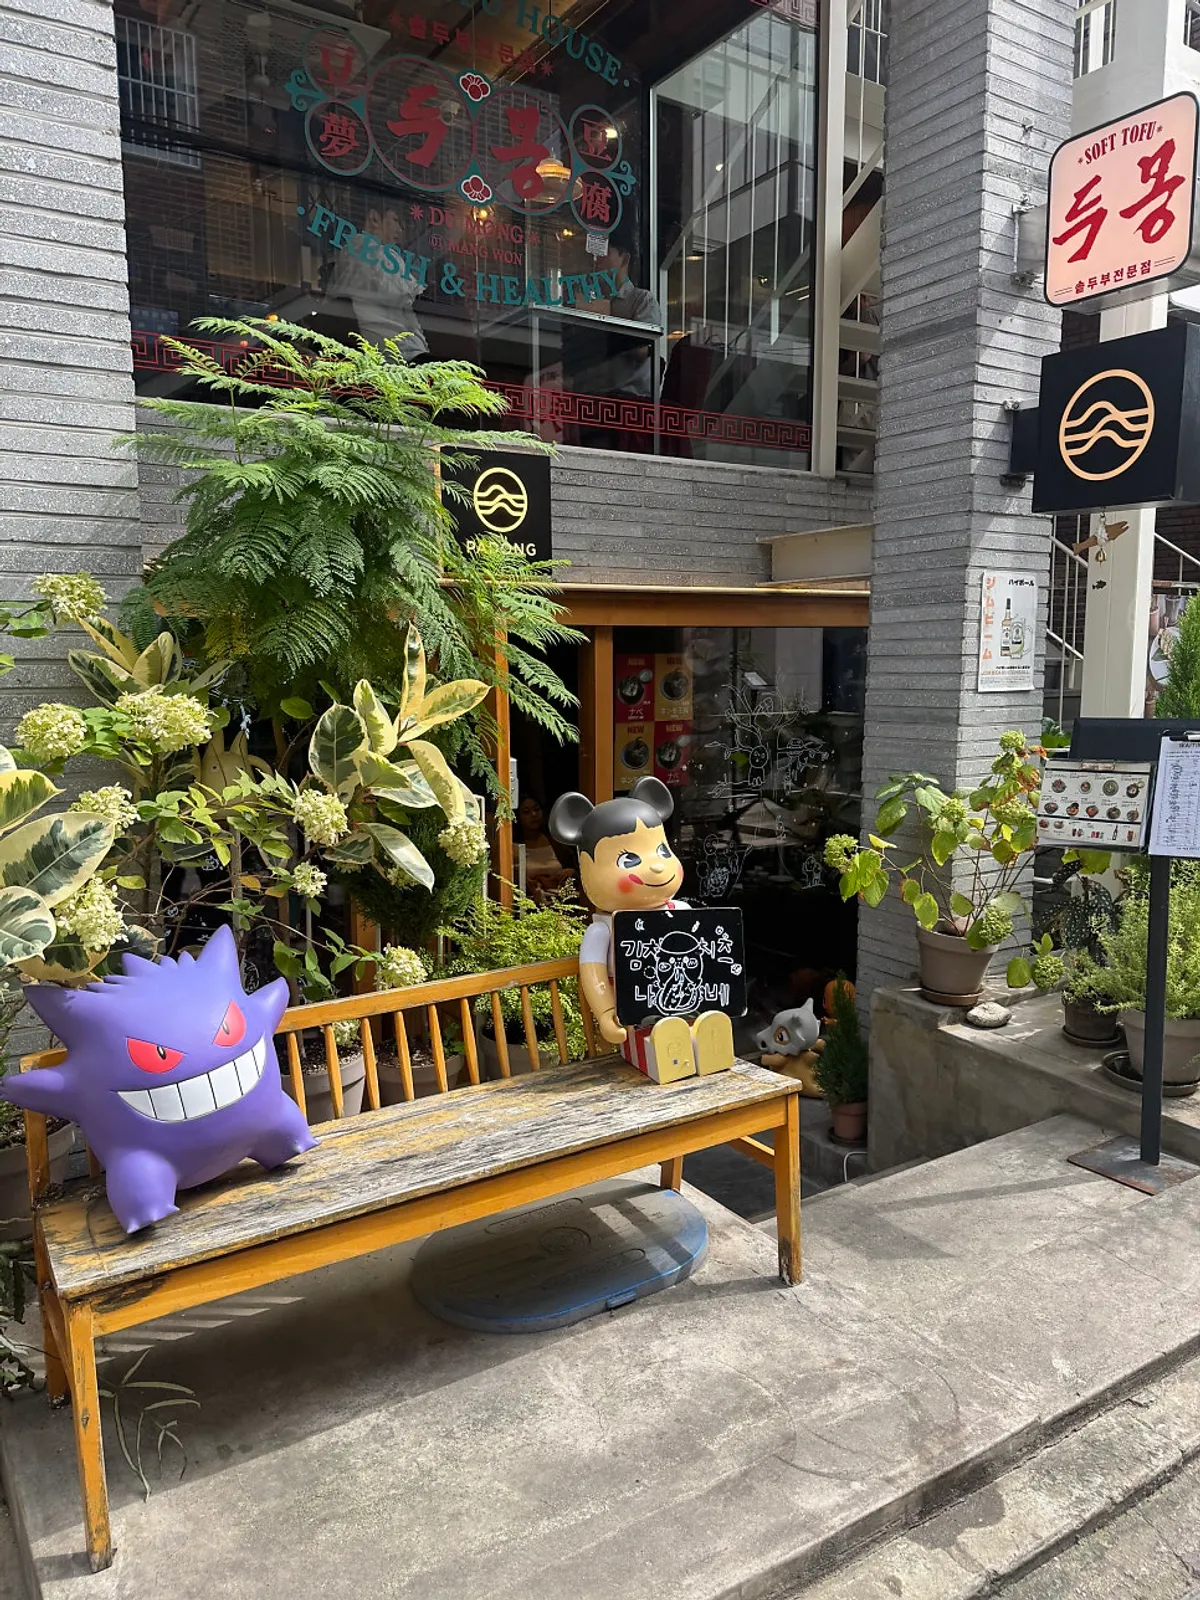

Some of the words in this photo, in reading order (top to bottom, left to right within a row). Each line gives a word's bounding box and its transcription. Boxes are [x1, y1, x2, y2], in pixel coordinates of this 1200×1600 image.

[518, 0, 622, 86] HOUSE
[386, 83, 549, 199] 두몽
[1083, 134, 1117, 165] SOFT
[1121, 121, 1157, 147] TOFU
[578, 117, 613, 224] 豆腐
[1052, 138, 1186, 264] 두몽
[464, 216, 523, 245] MONG
[307, 203, 432, 288] FRESH
[440, 262, 466, 297] &
[476, 268, 619, 306] HEALTHY
[492, 248, 523, 265] WON
[466, 540, 536, 556] RAONG
[1008, 578, 1035, 587] ハイボール
[627, 726, 645, 734] NEW
[665, 724, 684, 732] NEW
